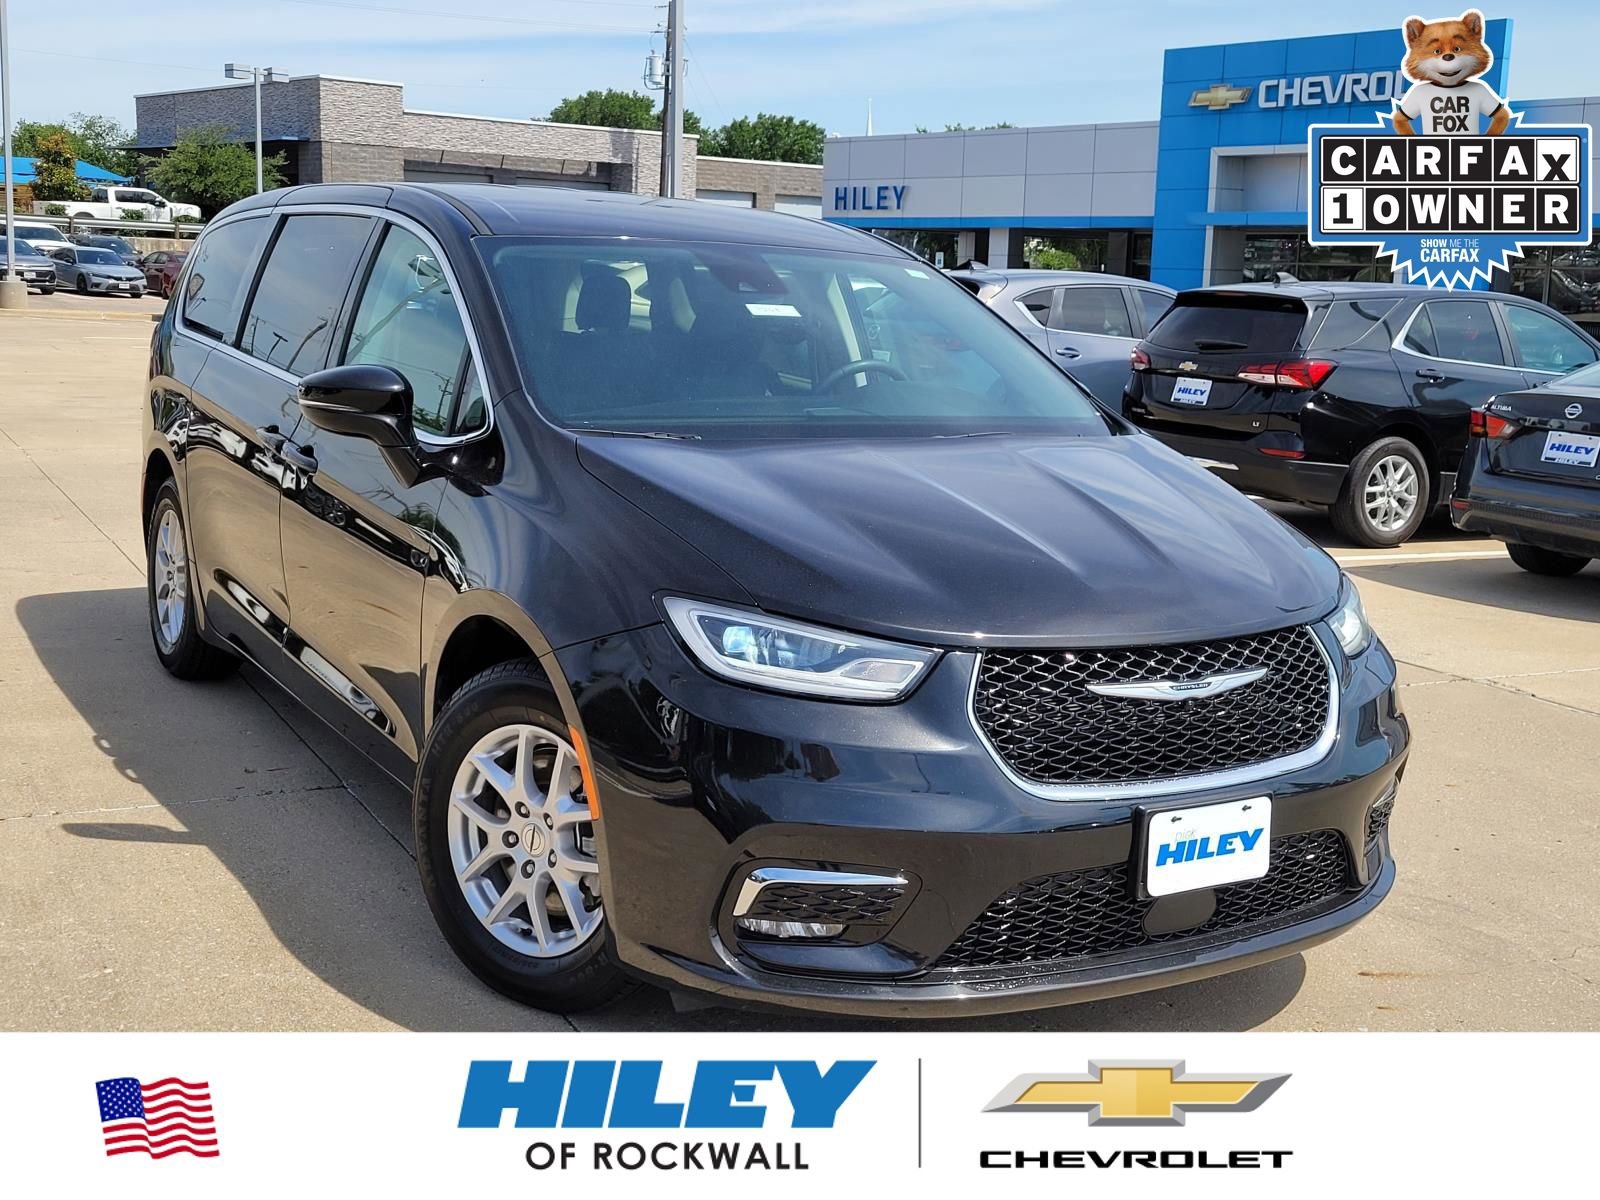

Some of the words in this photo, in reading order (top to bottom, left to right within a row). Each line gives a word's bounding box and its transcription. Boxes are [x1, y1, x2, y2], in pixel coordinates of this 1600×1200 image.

[1258, 70, 1406, 109] CHEVROL
[834, 186, 905, 210] HILEY
[1177, 386, 1207, 396] HILEY
[1549, 443, 1595, 455] HILEY
[1155, 828, 1265, 867] HILEY
